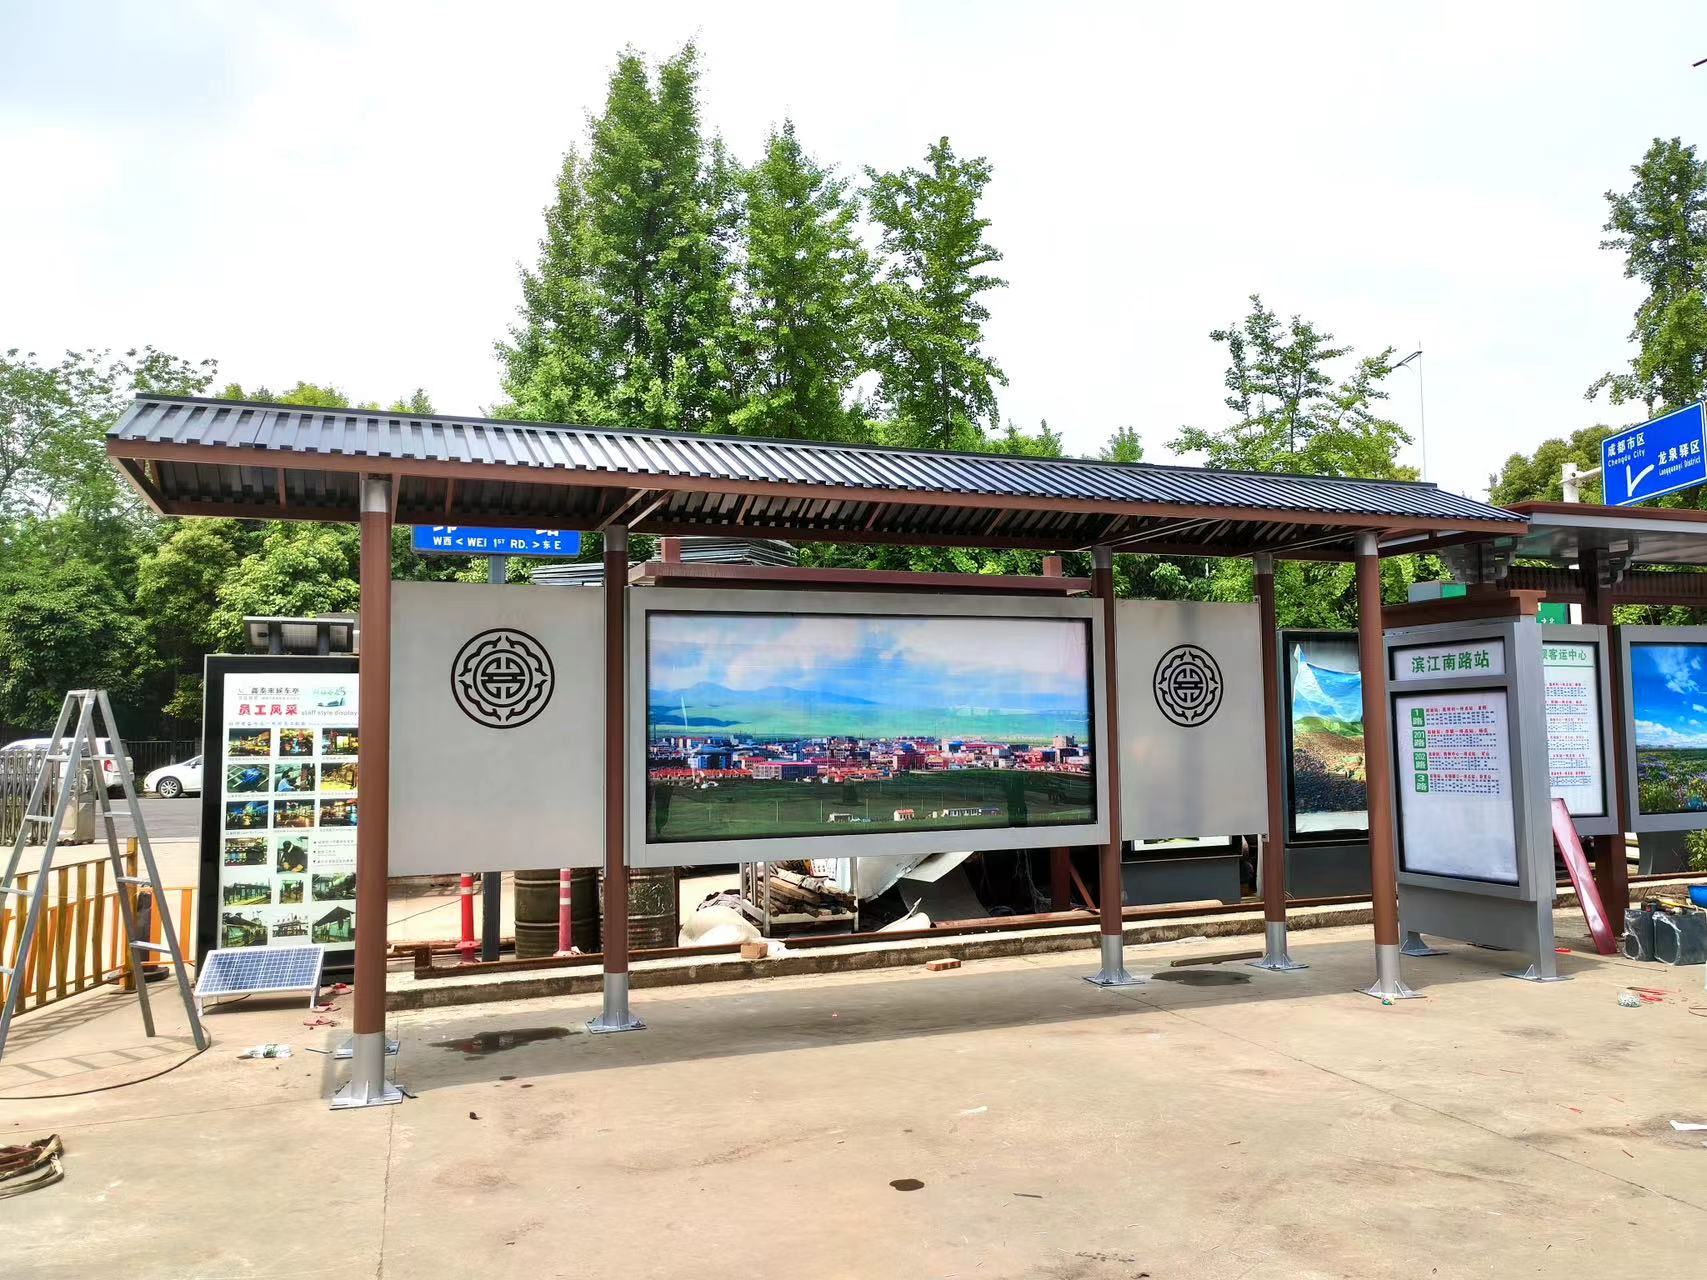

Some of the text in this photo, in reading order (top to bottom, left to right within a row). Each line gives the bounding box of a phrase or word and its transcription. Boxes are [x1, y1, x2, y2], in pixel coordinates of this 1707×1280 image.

[1608, 432, 1645, 457] 成都市区
[1658, 439, 1700, 465] 龙泉驿区
[1608, 449, 1645, 467] Chengdu City
[1684, 456, 1701, 468] District
[467, 537, 487, 547] WEI
[510, 540, 528, 549] RD.
[1411, 649, 1490, 673] 滨江南路站
[238, 703, 298, 716] 员工风采
